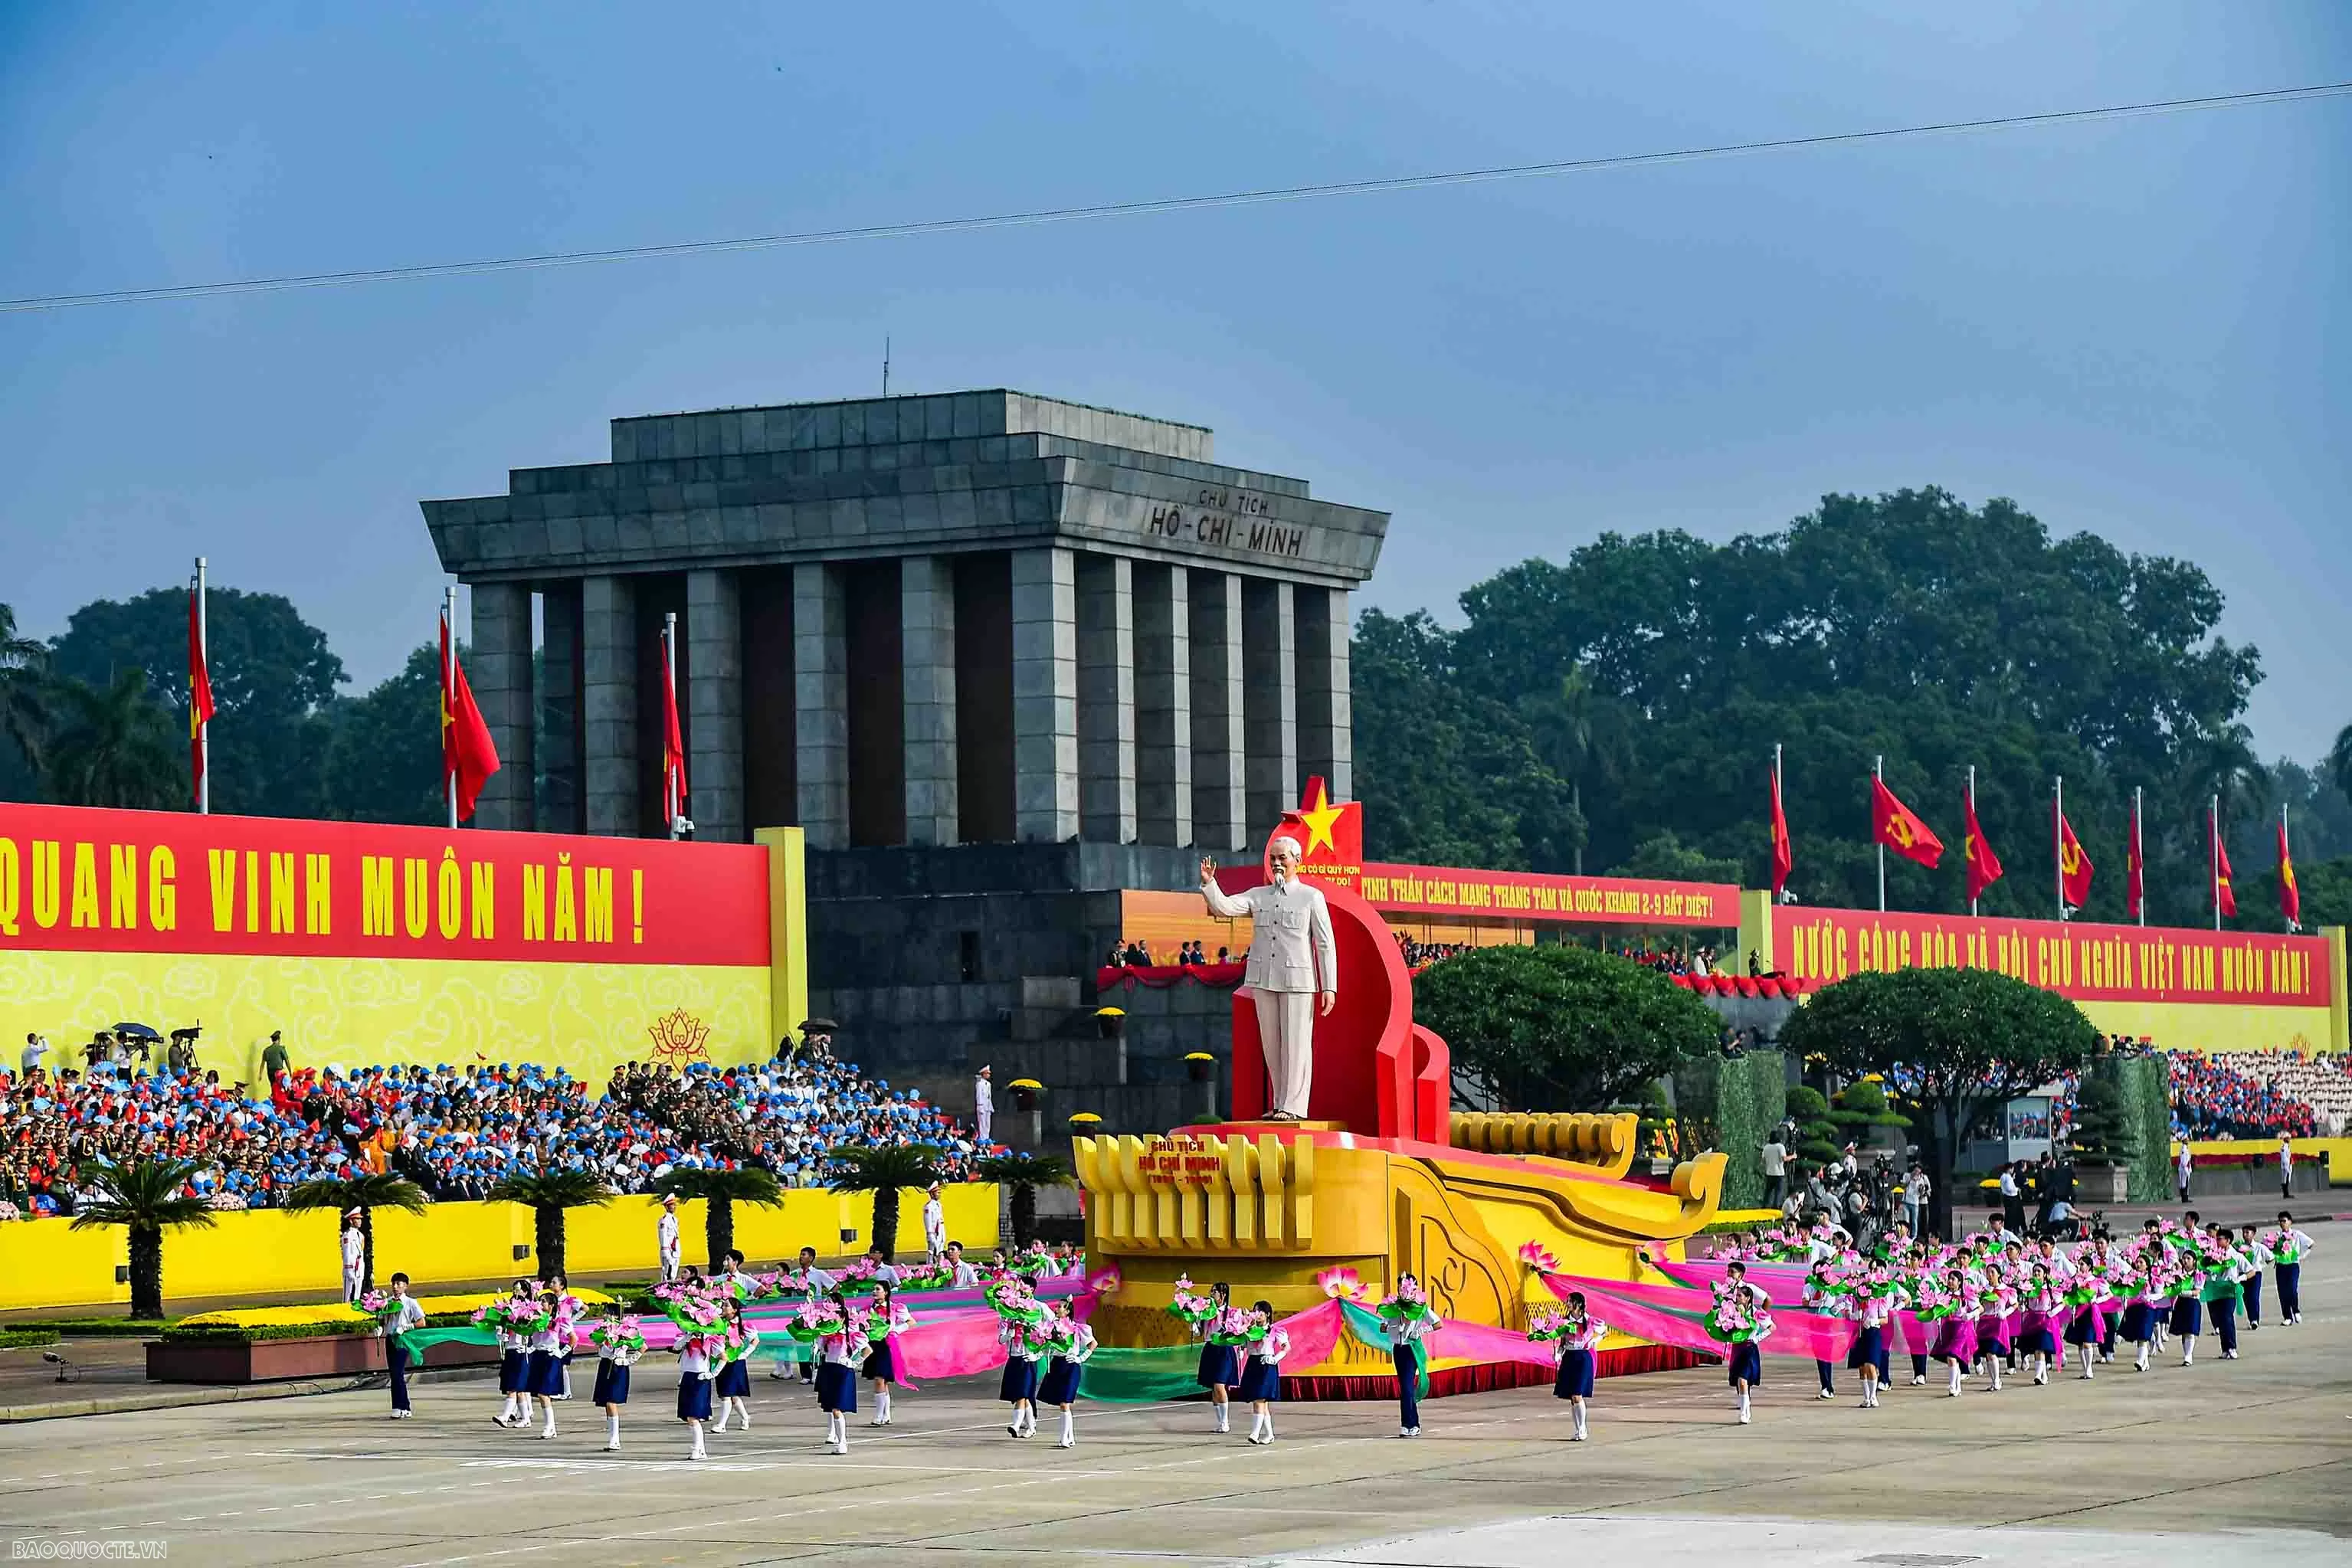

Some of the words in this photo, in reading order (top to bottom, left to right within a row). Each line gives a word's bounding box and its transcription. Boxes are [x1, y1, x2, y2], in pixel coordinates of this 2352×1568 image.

[0, 837, 176, 936] QUANG
[208, 849, 331, 935] VINH
[362, 846, 495, 940] MUÔN
[523, 852, 614, 943] NĂM
[1426, 877, 1456, 905] CÁCH
[1459, 882, 1491, 912] MẠNG
[1493, 880, 1531, 909] THÁNG
[1532, 882, 1557, 911] TÁM
[1558, 883, 1574, 912] VÀ
[1575, 883, 1603, 913] QUỐC
[1605, 886, 1640, 914] KHÁNH
[1642, 893, 1662, 915] 2-9
[1663, 889, 1683, 916] BẤT
[1793, 917, 1848, 980] NƯỚC
[2039, 926, 2072, 987] CHỦ
[2081, 934, 2132, 990] NGHĨA
[2139, 935, 2174, 999] VIỆT
[2182, 944, 2214, 991] NAM
[2222, 939, 2265, 993] MUÔN
[1177, 1141, 1204, 1154] TỊCH
[1184, 1157, 1220, 1171] MINH
